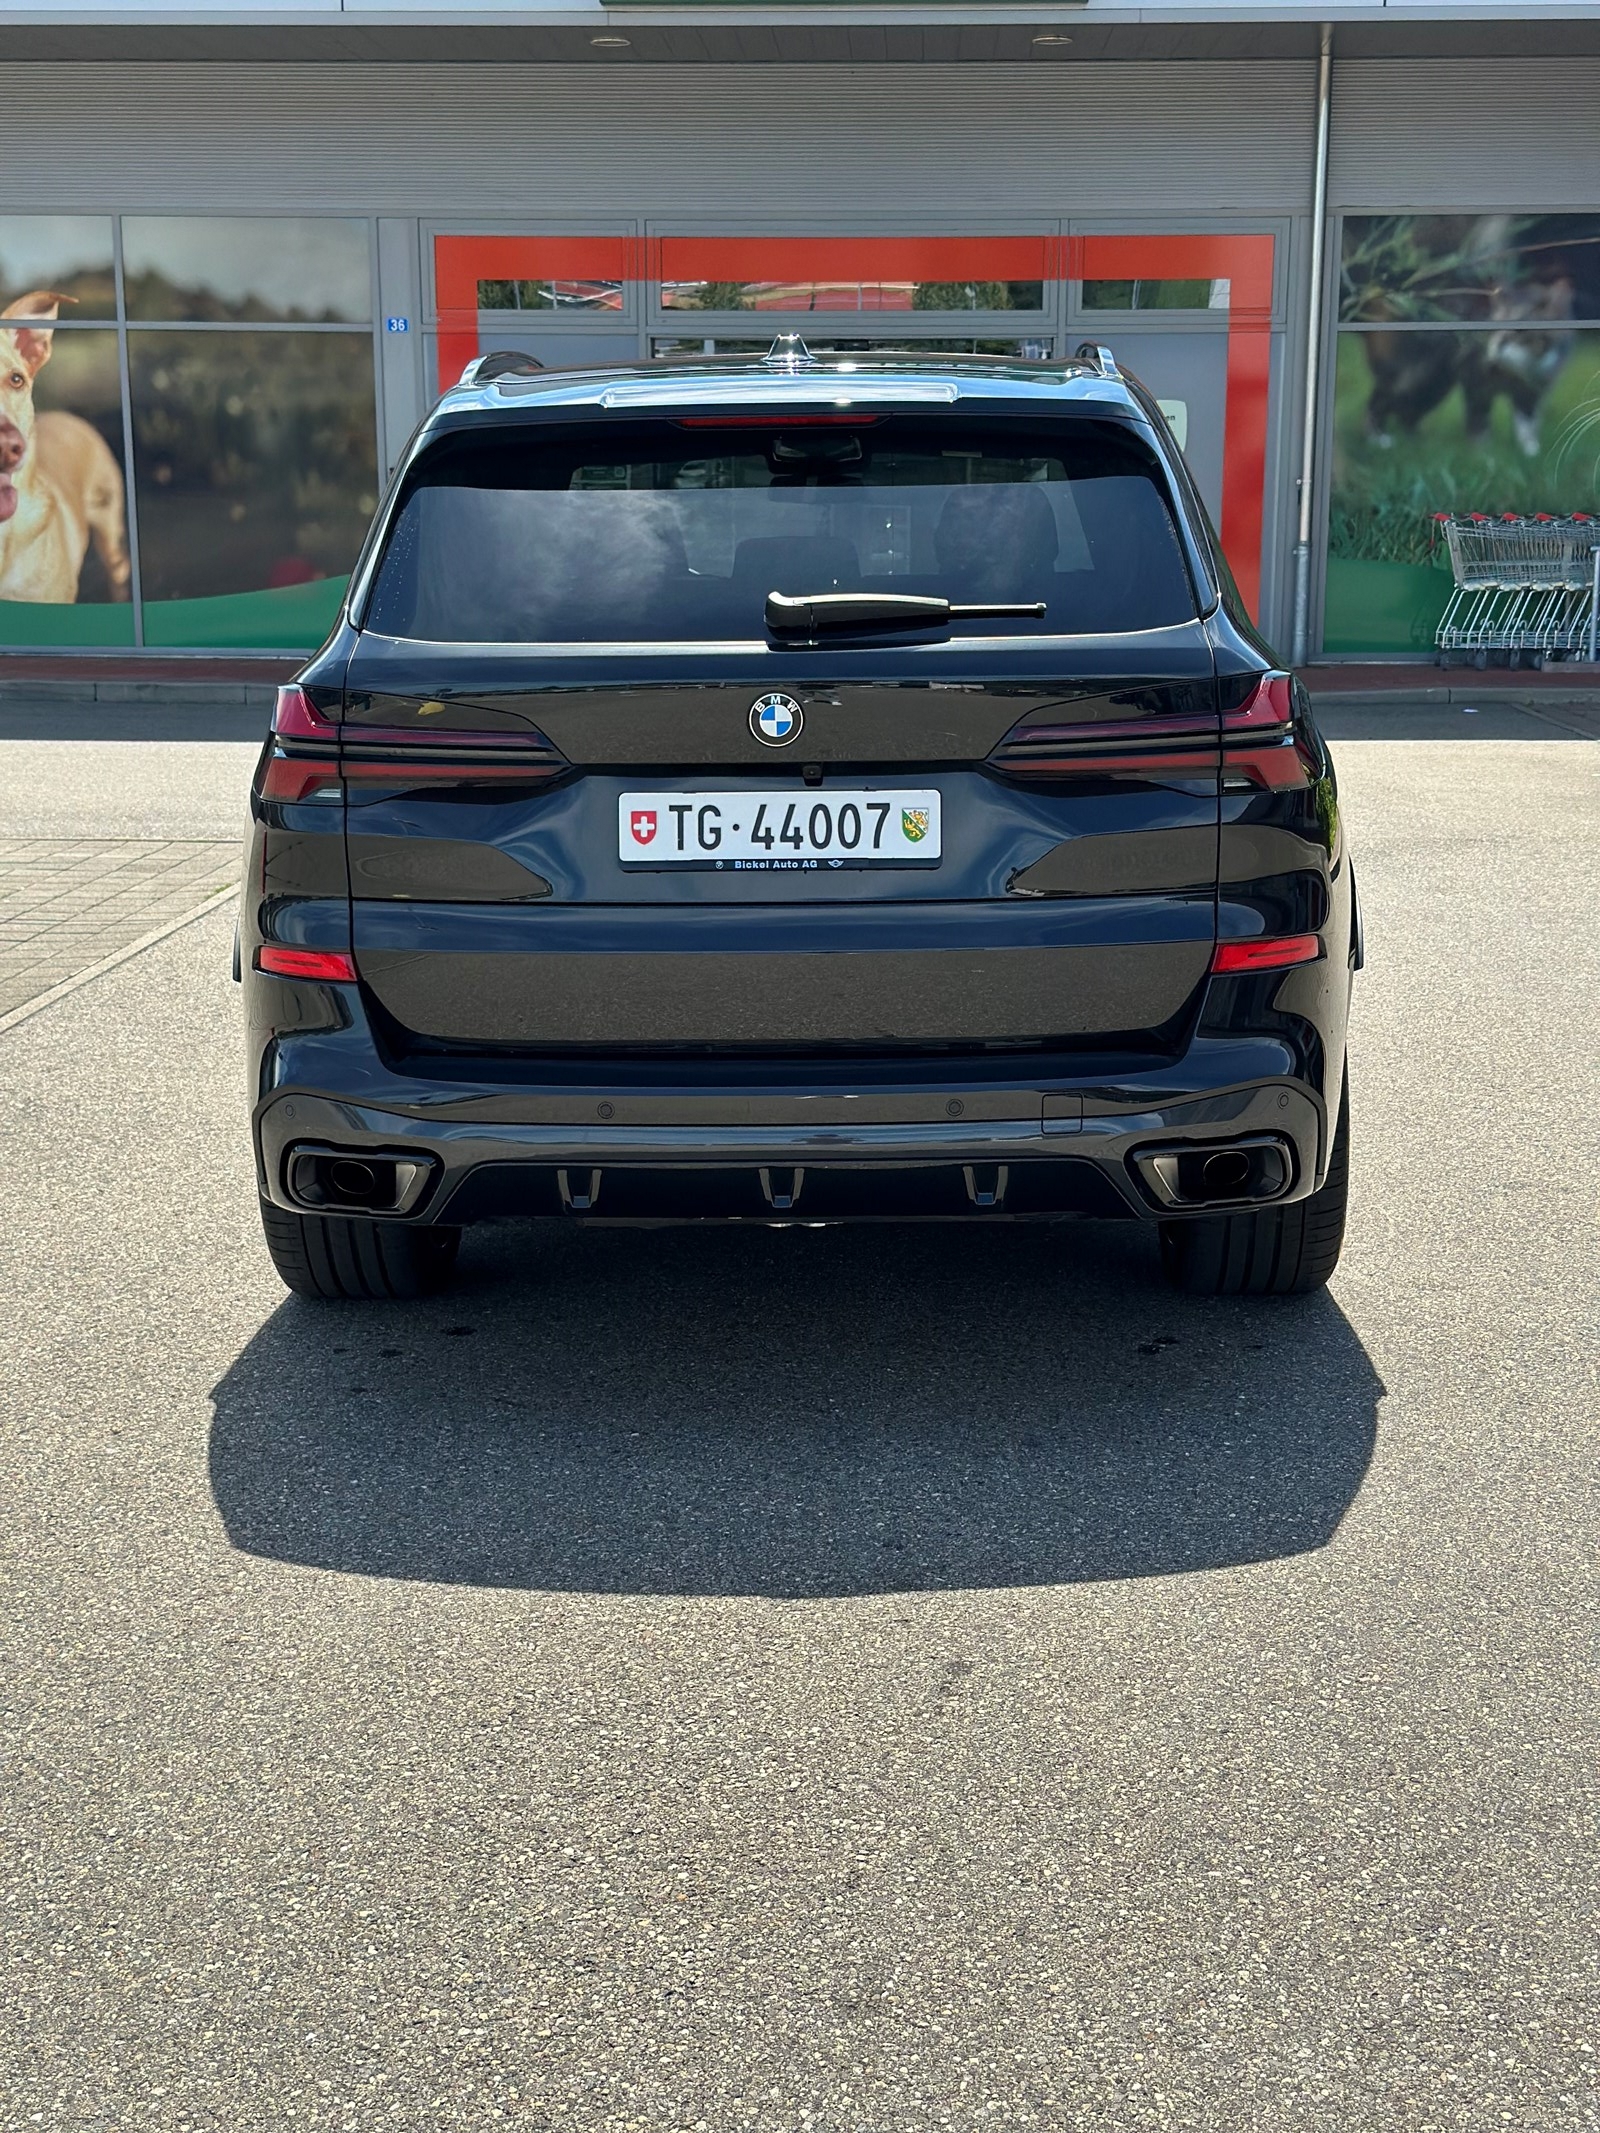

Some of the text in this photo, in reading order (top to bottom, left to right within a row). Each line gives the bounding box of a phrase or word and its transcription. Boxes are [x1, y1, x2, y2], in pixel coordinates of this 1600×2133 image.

[391, 319, 405, 331] 36
[754, 695, 798, 713] BMW
[734, 860, 818, 869] Bickel Auto AG
